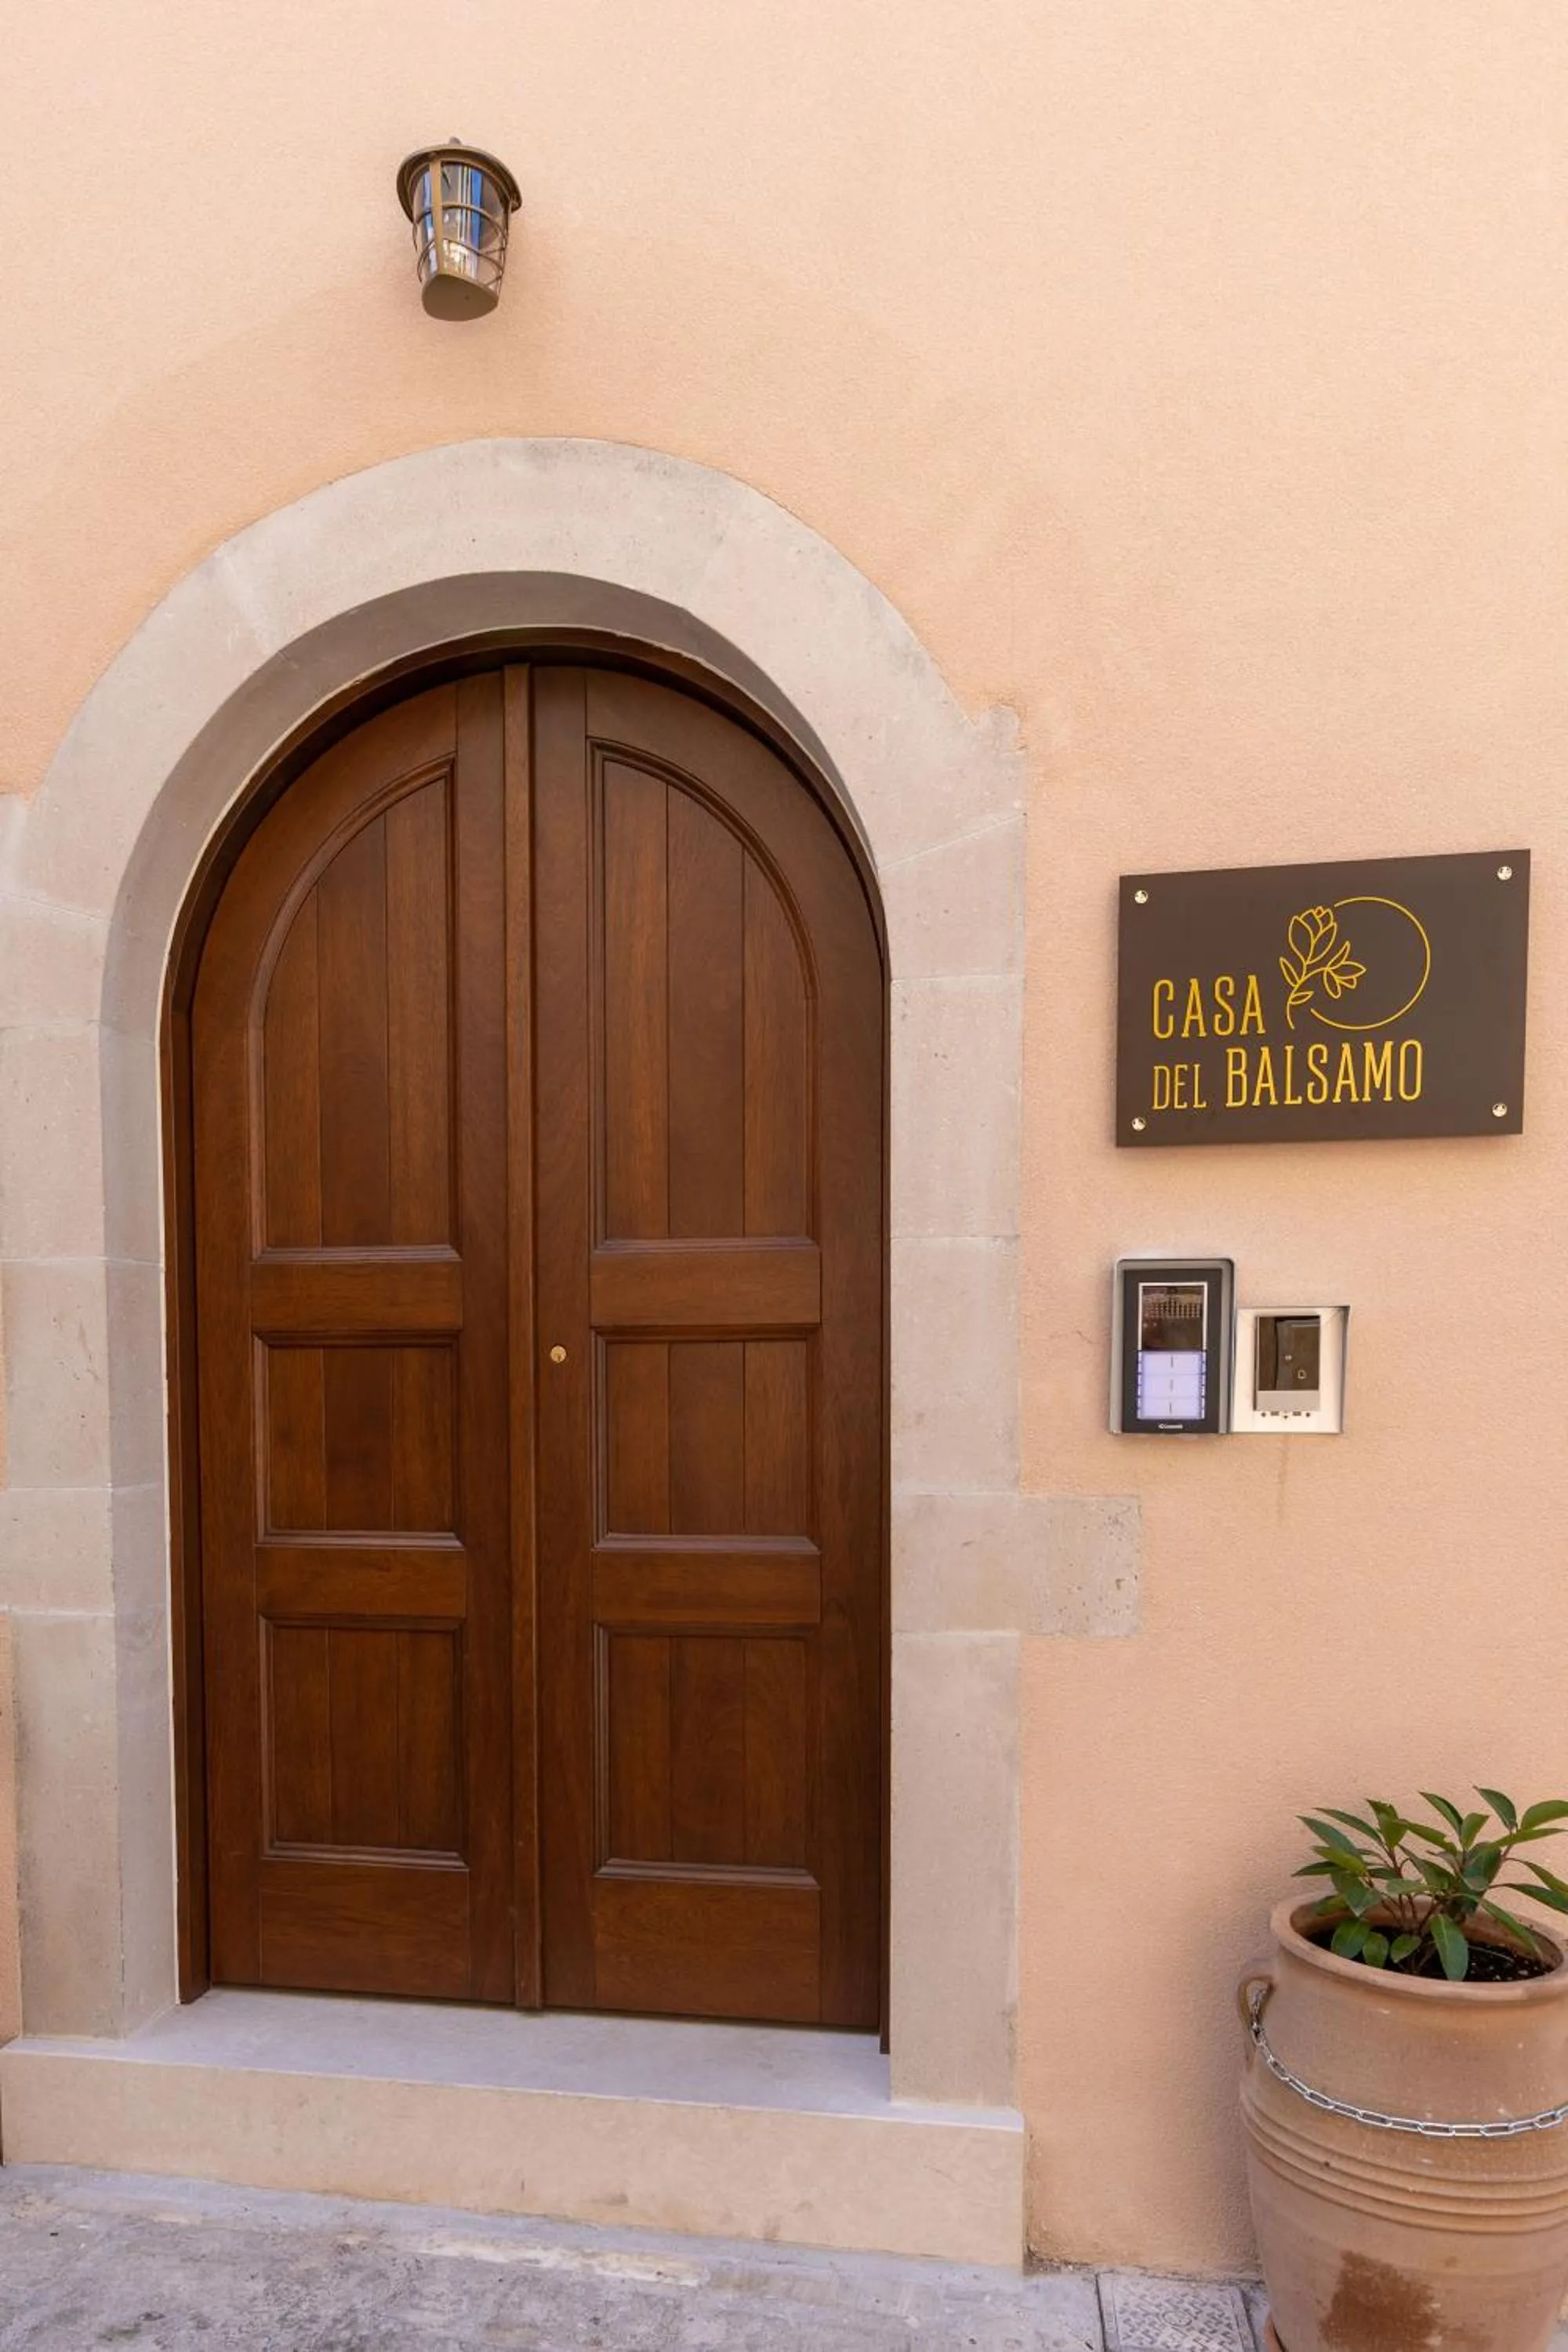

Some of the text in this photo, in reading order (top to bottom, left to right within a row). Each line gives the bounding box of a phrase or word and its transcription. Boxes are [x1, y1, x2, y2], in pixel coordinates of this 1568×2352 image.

[1152, 975, 1266, 1040] CASA
[1152, 1039, 1423, 1110] DEL BALSAMO
